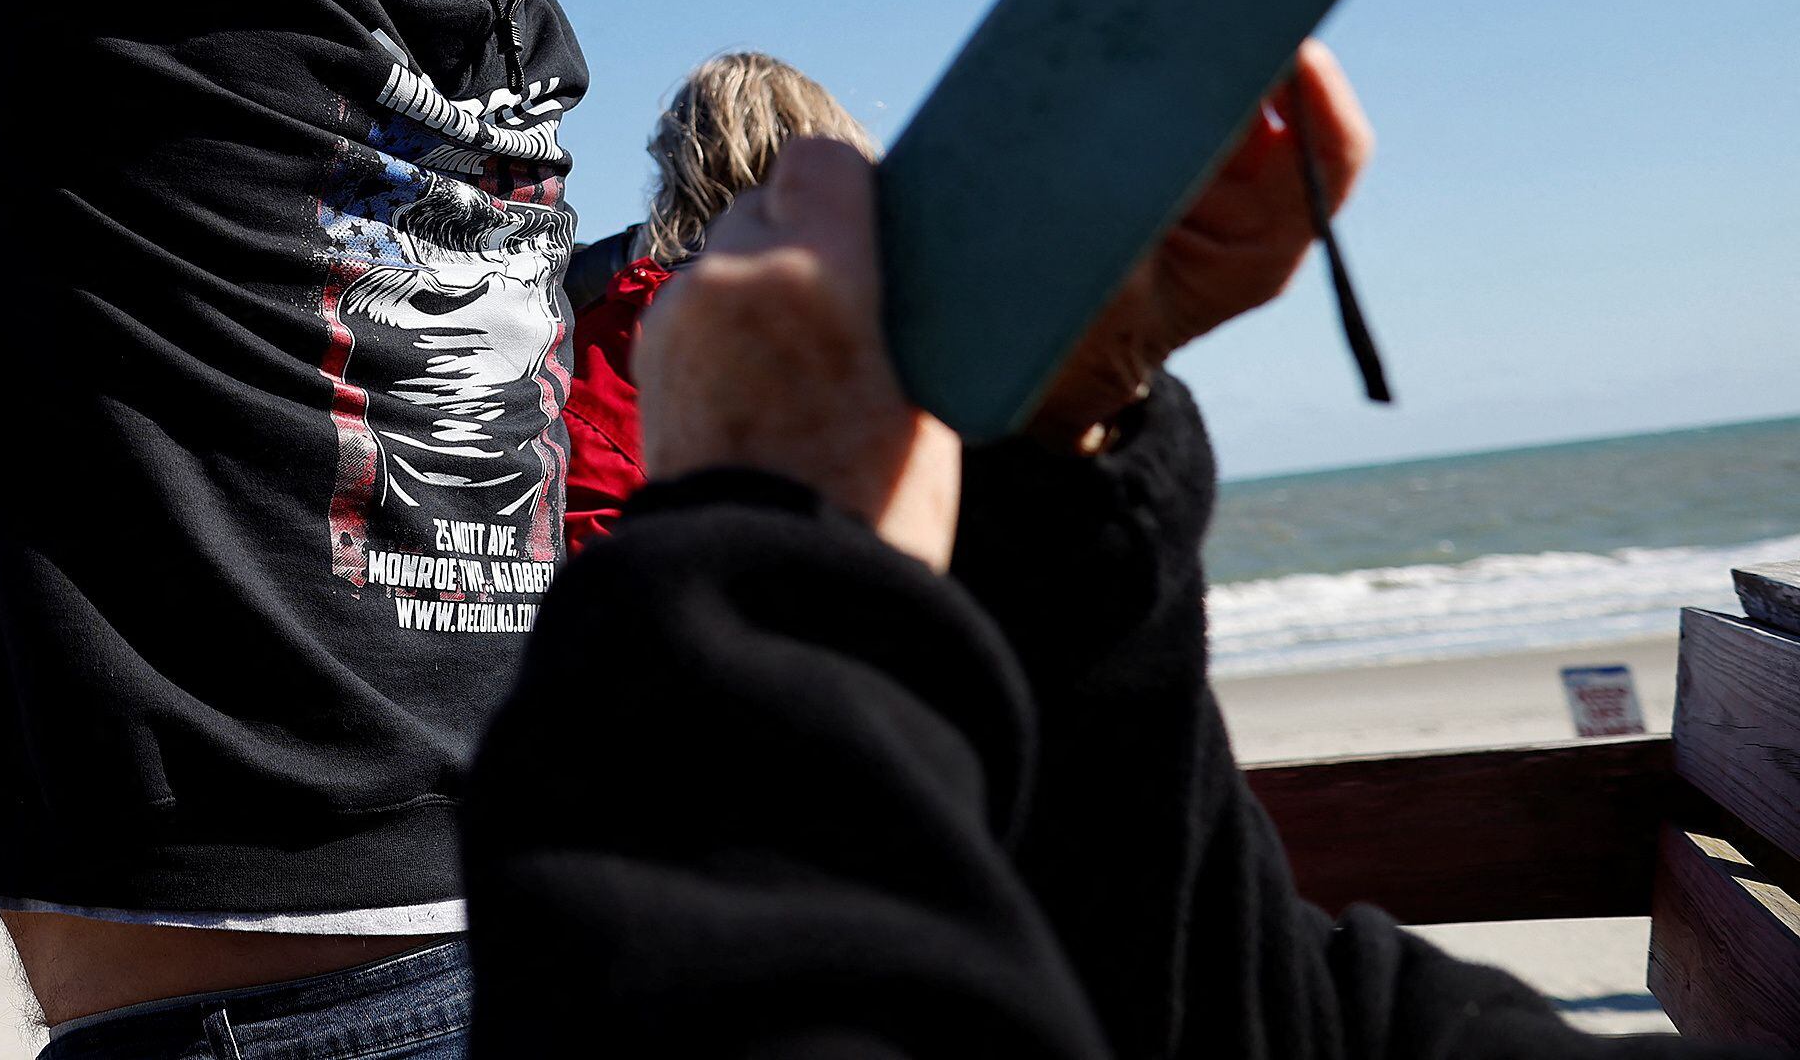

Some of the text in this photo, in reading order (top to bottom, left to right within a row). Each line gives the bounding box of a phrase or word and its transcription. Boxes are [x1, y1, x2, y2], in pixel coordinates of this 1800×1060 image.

[433, 518, 517, 557] 25 MOTT AVE.
[368, 550, 459, 592] MONROE
[491, 561, 514, 593] NJ
